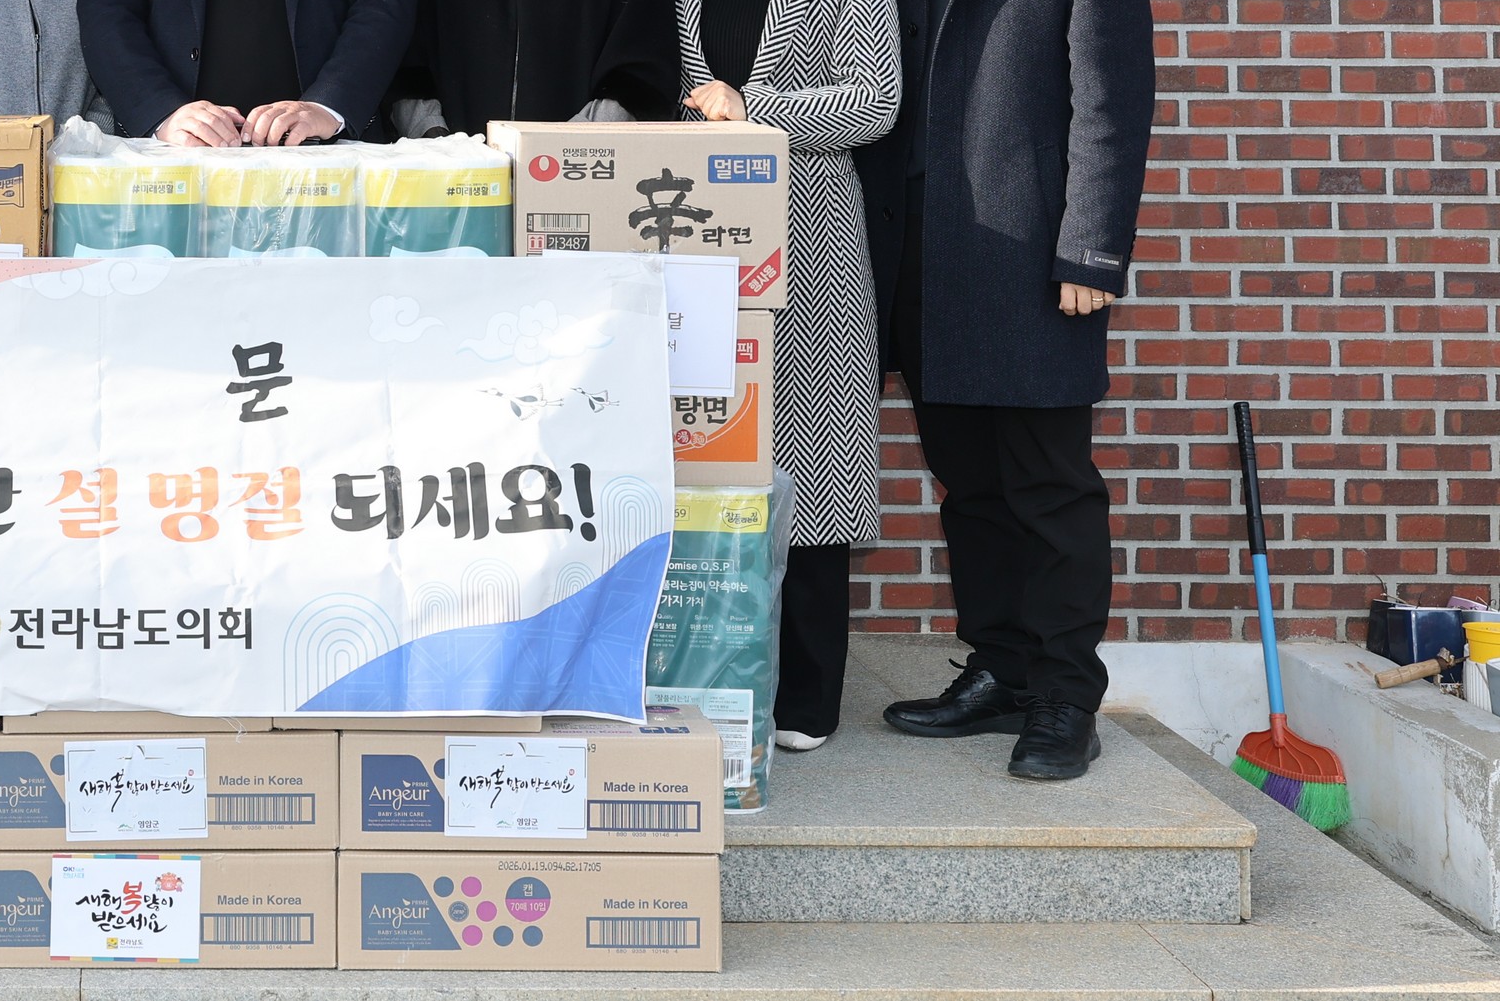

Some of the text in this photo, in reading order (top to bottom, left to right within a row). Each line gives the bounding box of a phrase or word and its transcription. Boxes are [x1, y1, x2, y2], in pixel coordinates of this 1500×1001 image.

[562, 148, 615, 157] 인생을 맛있게
[561, 159, 615, 180] 농심
[713, 159, 772, 180] 멀티팩
[446, 186, 488, 196] #미래생활
[548, 237, 587, 250] 가3487
[701, 226, 752, 247] 라면
[748, 264, 776, 293] 행사용
[224, 339, 294, 424] 문
[43, 464, 117, 543] 설
[146, 462, 306, 543] 명절
[329, 460, 598, 543] 되세요!
[701, 562, 730, 572] Q.S.P
[709, 580, 748, 593] 약속하는
[661, 595, 704, 607] 가지 가치
[8, 607, 252, 649] 전라남도의회
[459, 775, 491, 791] 새해
[506, 776, 528, 793] 많이
[530, 774, 575, 794] 받으세요
[604, 782, 688, 793] Made in Korea
[368, 786, 430, 810] Angeur
[517, 818, 538, 826] 영암군
[75, 881, 173, 914] 새해 복 많이
[523, 884, 533, 896] 캡
[510, 902, 546, 911] 70매 10입
[603, 899, 688, 909] Made in Korea
[91, 912, 167, 934] 받으세요
[368, 904, 430, 929] Angeur
[119, 938, 144, 946] 전라남도
